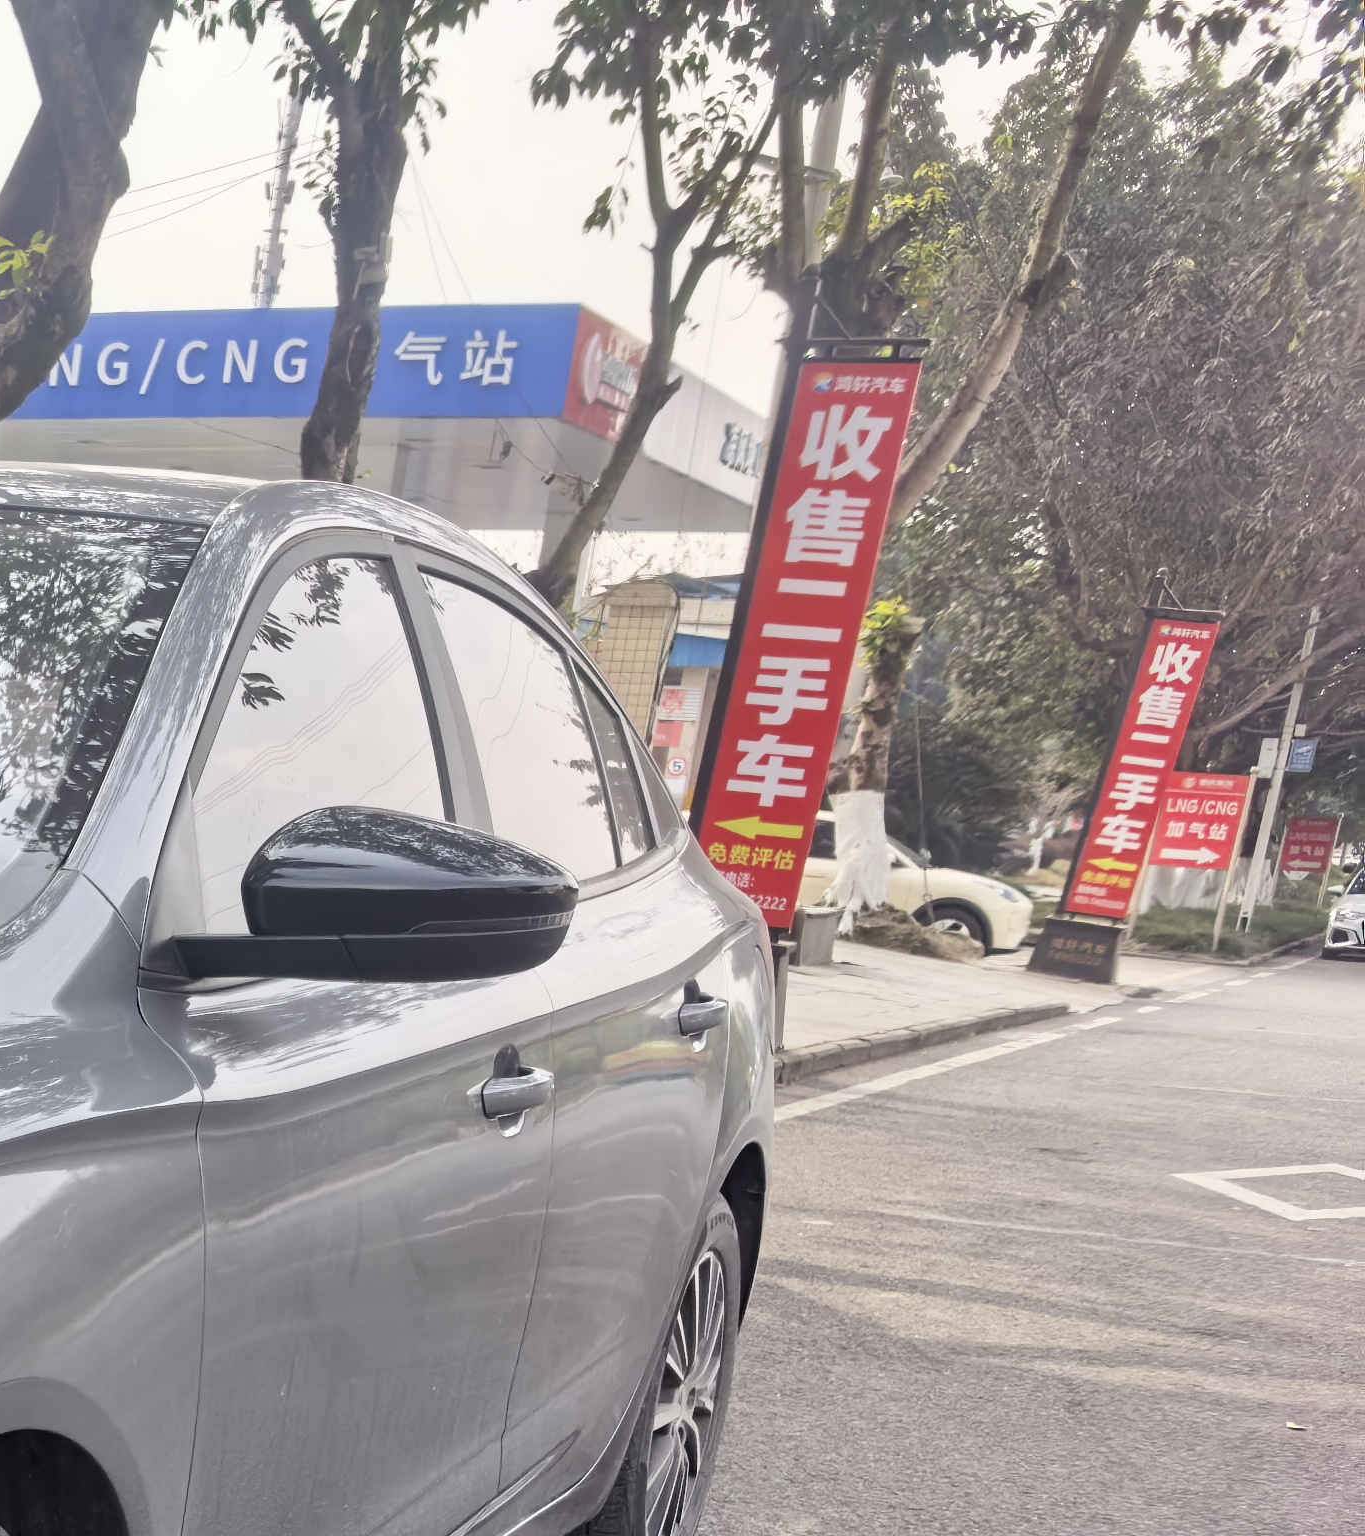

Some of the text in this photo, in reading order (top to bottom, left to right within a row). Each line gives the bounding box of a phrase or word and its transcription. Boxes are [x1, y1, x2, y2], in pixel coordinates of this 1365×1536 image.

[725, 403, 893, 808] 收售二手车
[1095, 641, 1202, 854] 收售二手车
[1165, 798, 1239, 816] LNG/CNG
[1165, 821, 1229, 841] 加气站
[708, 842, 796, 871] 免费评估
